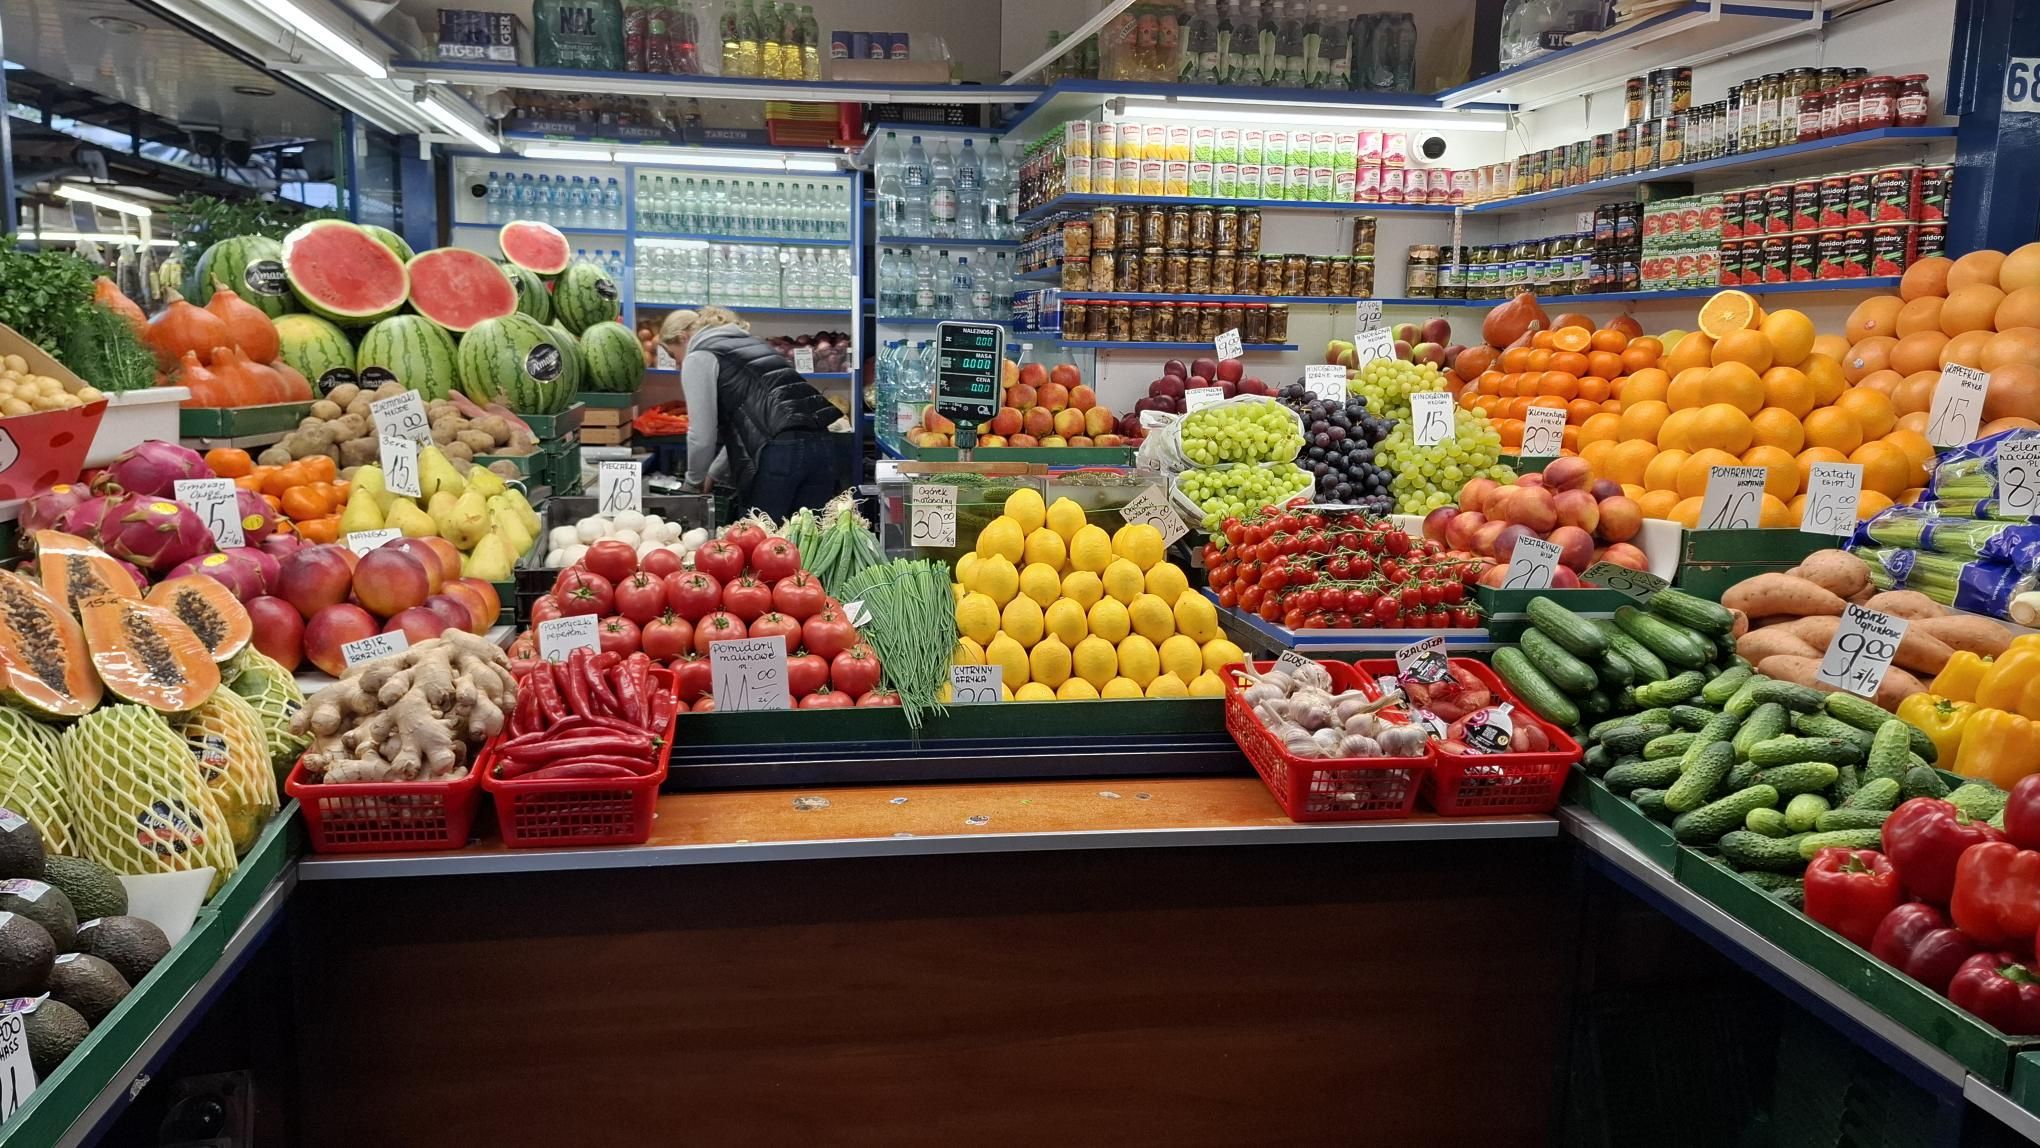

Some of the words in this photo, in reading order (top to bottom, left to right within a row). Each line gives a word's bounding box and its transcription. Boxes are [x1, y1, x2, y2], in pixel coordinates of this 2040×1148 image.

[439, 44, 485, 58] TIGER
[1945, 363, 1985, 382] GRAPEFRUIT
[1417, 411, 1447, 443] 15
[1929, 397, 1969, 447] 15
[386, 455, 410, 489] 15
[1813, 467, 1856, 488] Bataty
[2004, 467, 2035, 508] 8
[346, 636, 388, 655] IMBIR
[720, 652, 777, 662] malinowe
[954, 666, 993, 675] CYTRYNY
[955, 675, 987, 683] AFRYKA
